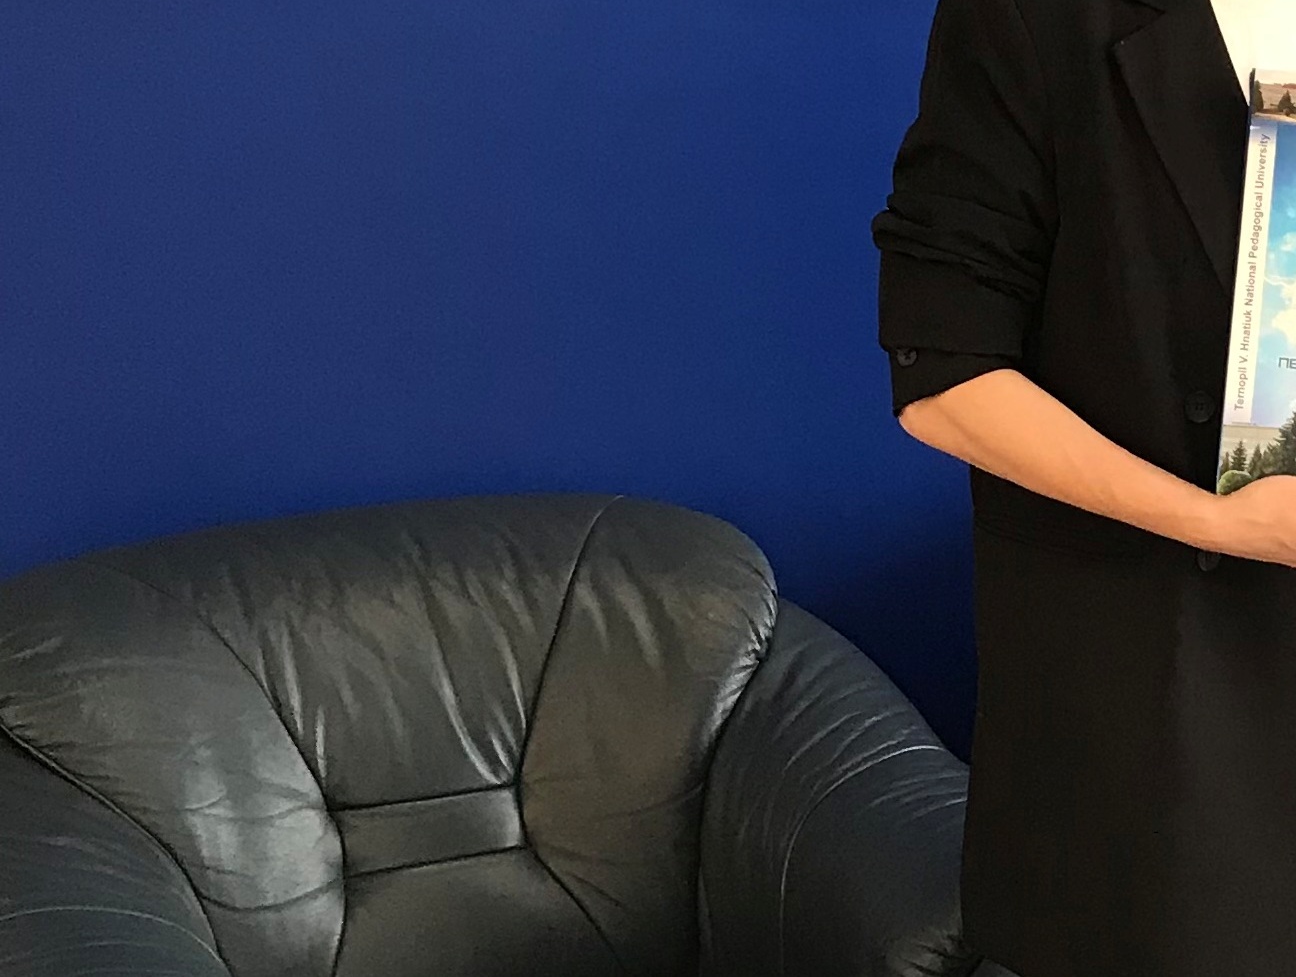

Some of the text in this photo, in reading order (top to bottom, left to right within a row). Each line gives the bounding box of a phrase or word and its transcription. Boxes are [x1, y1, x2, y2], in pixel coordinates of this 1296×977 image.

[1234, 133, 1271, 411] Ternopil V. Hnatiuk National Pedagogical University
